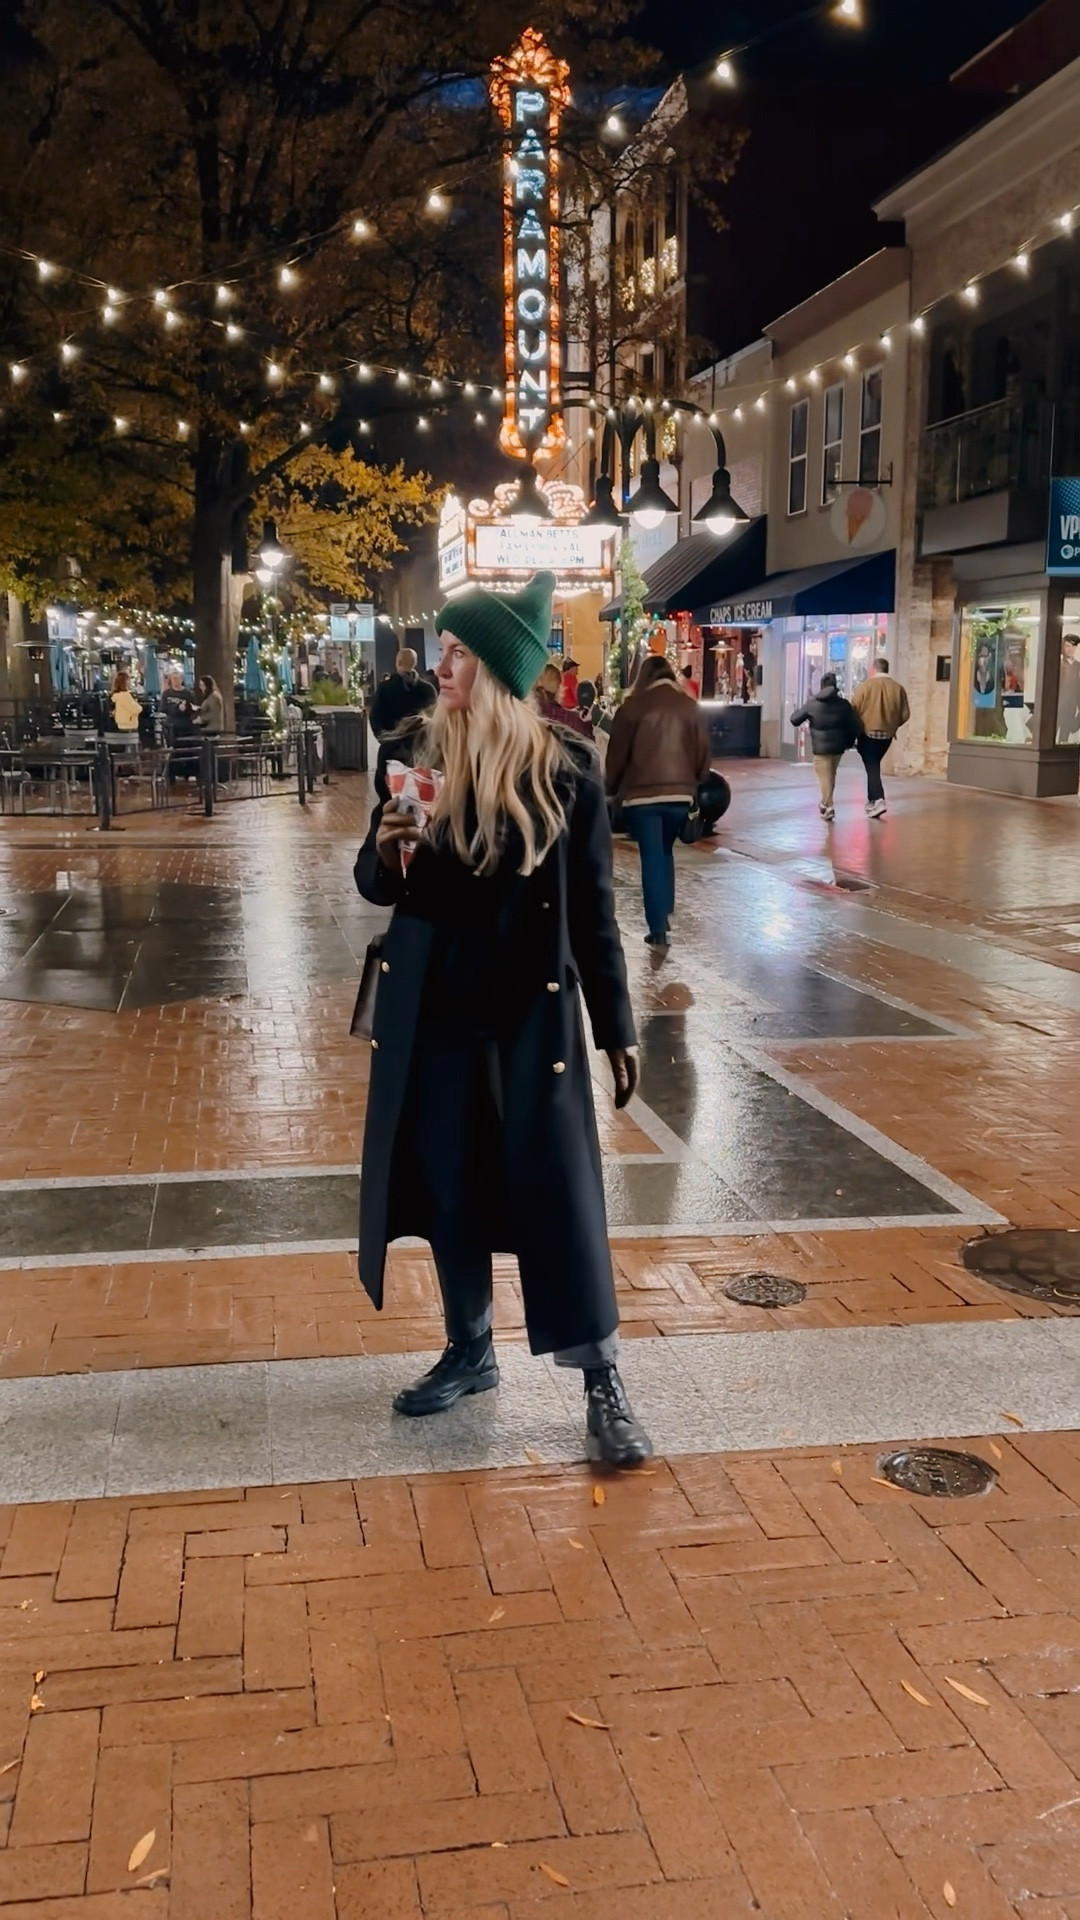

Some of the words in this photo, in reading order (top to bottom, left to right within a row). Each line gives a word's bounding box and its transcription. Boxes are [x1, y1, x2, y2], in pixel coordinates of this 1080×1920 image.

[516, 91, 547, 431] PARAMOUNT
[1060, 515, 1080, 540] VP
[710, 606, 732, 624] CHAPS
[733, 604, 745, 621] ICE
[745, 601, 773, 620] CREAM
